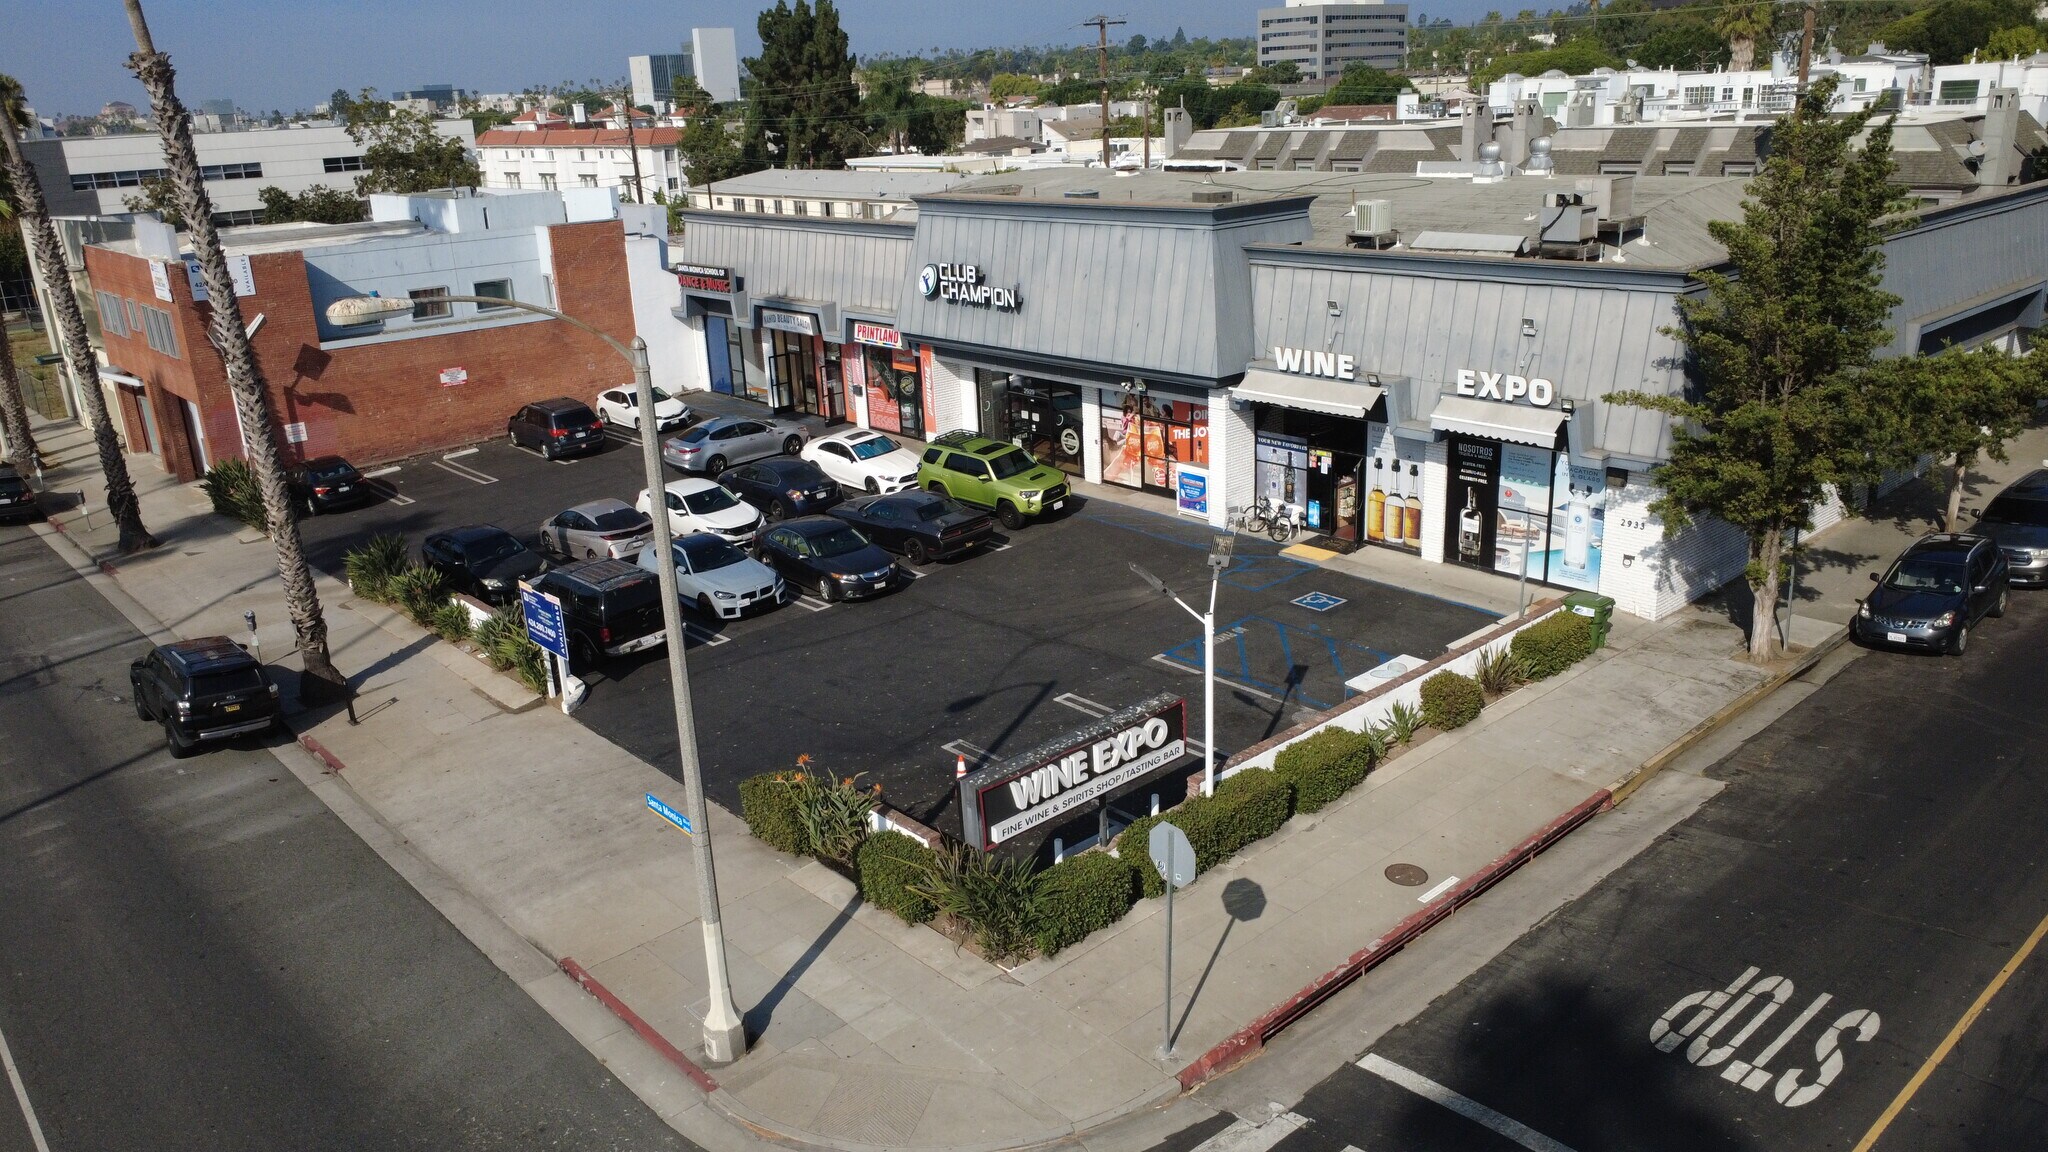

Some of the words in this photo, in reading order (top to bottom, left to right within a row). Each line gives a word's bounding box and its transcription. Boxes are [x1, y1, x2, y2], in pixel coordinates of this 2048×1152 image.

[241, 258, 252, 292] AVAILABLE
[689, 266, 704, 274] MONICA
[704, 267, 719, 275] SCHOOL
[940, 262, 976, 284] CLUB
[678, 274, 700, 288] DANCE
[708, 277, 730, 292] MUSIC
[940, 282, 1014, 308] CHAMPION
[777, 314, 796, 324] BEAUTY
[857, 325, 899, 344] PRINTLAND
[1274, 346, 1354, 380] WINE
[1457, 368, 1552, 406] EXPO
[1173, 428, 1190, 439] THE
[1458, 442, 1493, 457] NOSOTROS
[1565, 466, 1598, 477] VACATION
[1621, 519, 1645, 530] 2933
[555, 605, 566, 654] AVAILABLE
[1009, 750, 1088, 810] WINE
[1092, 717, 1168, 774] EXPO
[1002, 821, 1023, 837] FINE
[1025, 808, 1050, 826] WINE
[1052, 804, 1060, 814] &
[1062, 787, 1094, 809] SPIRITS
[1164, 746, 1180, 760] BAR
[647, 795, 662, 812] Santa
[662, 805, 682, 825] Monica
[1650, 966, 1880, 1107] STOP
